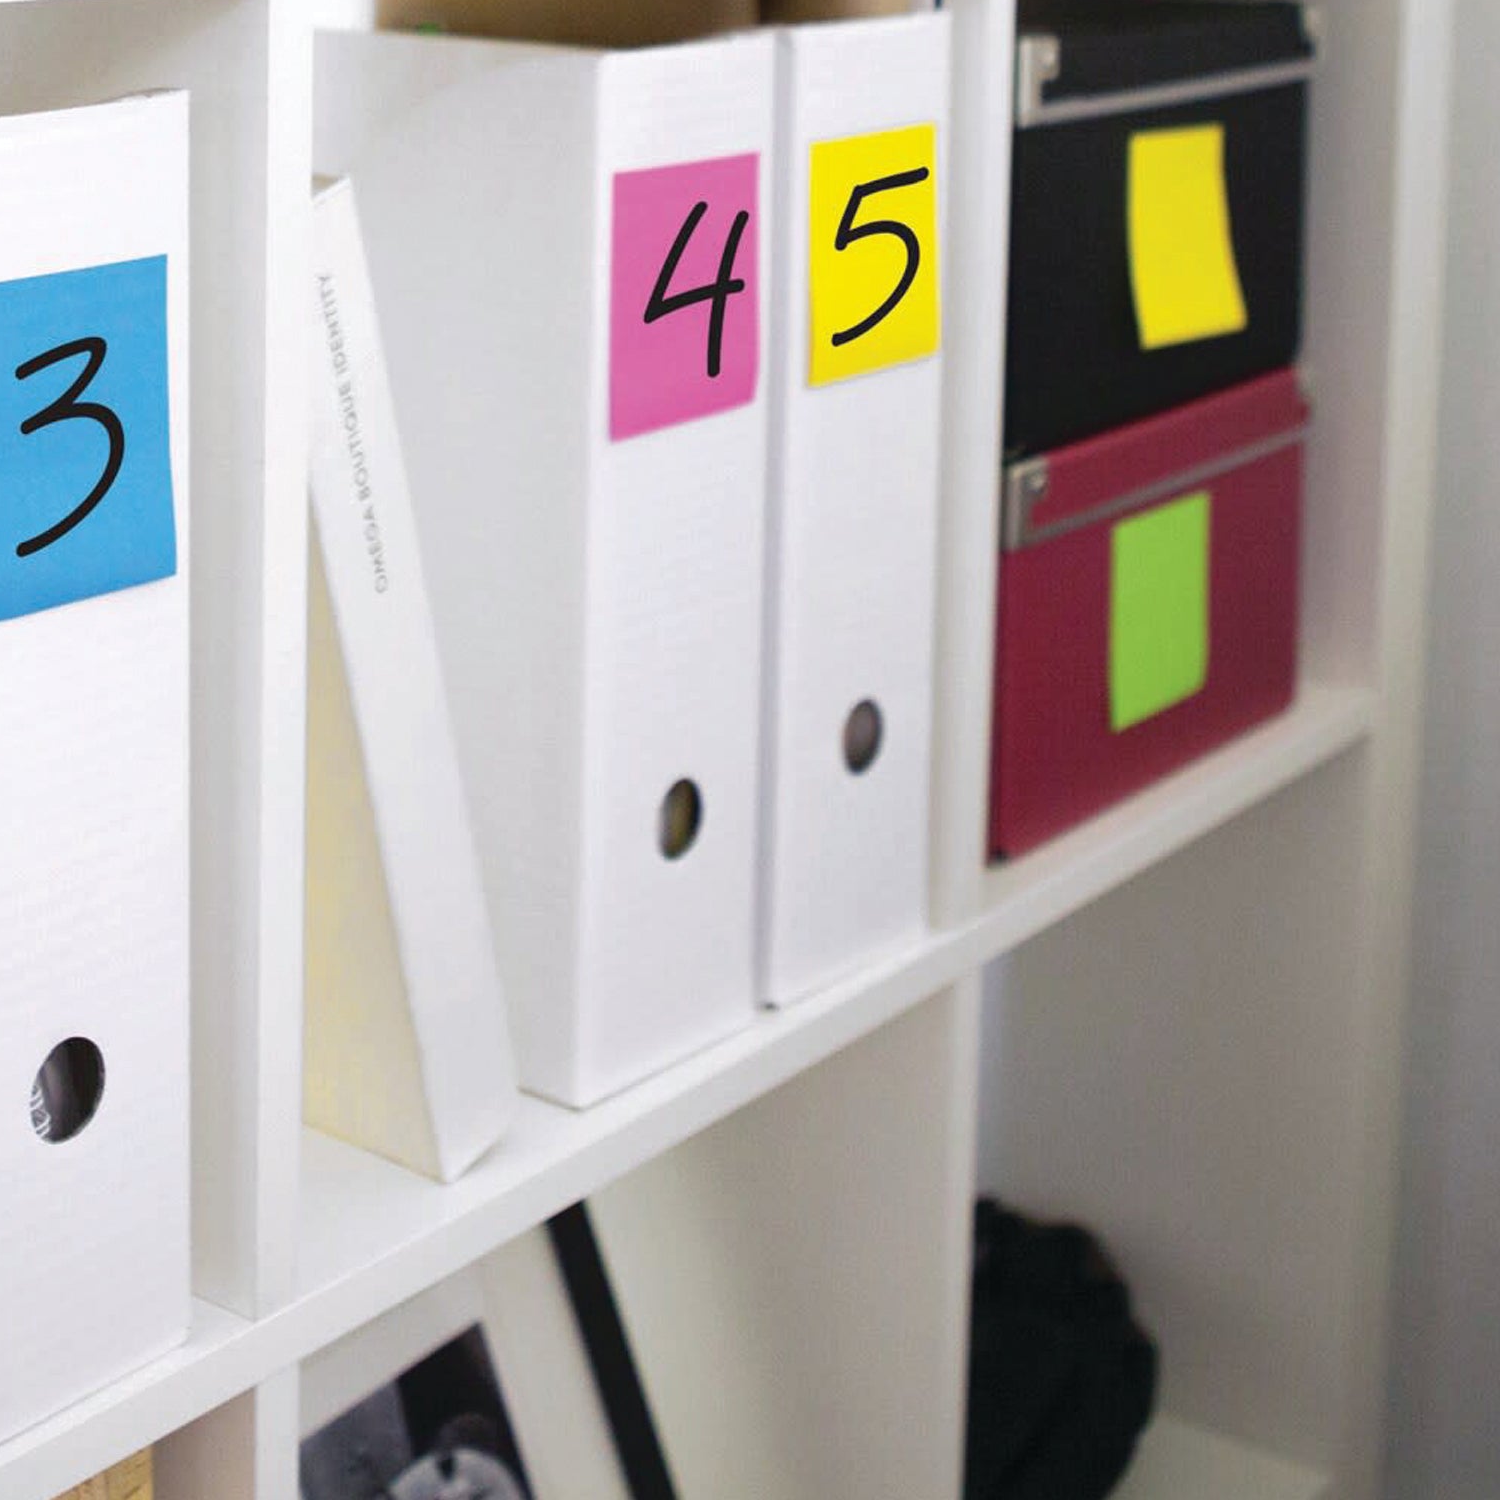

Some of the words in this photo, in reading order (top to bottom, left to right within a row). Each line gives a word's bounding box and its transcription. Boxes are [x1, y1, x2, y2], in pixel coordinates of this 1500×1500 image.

[644, 202, 748, 377] 4
[832, 167, 929, 346] 5
[15, 336, 125, 558] 3
